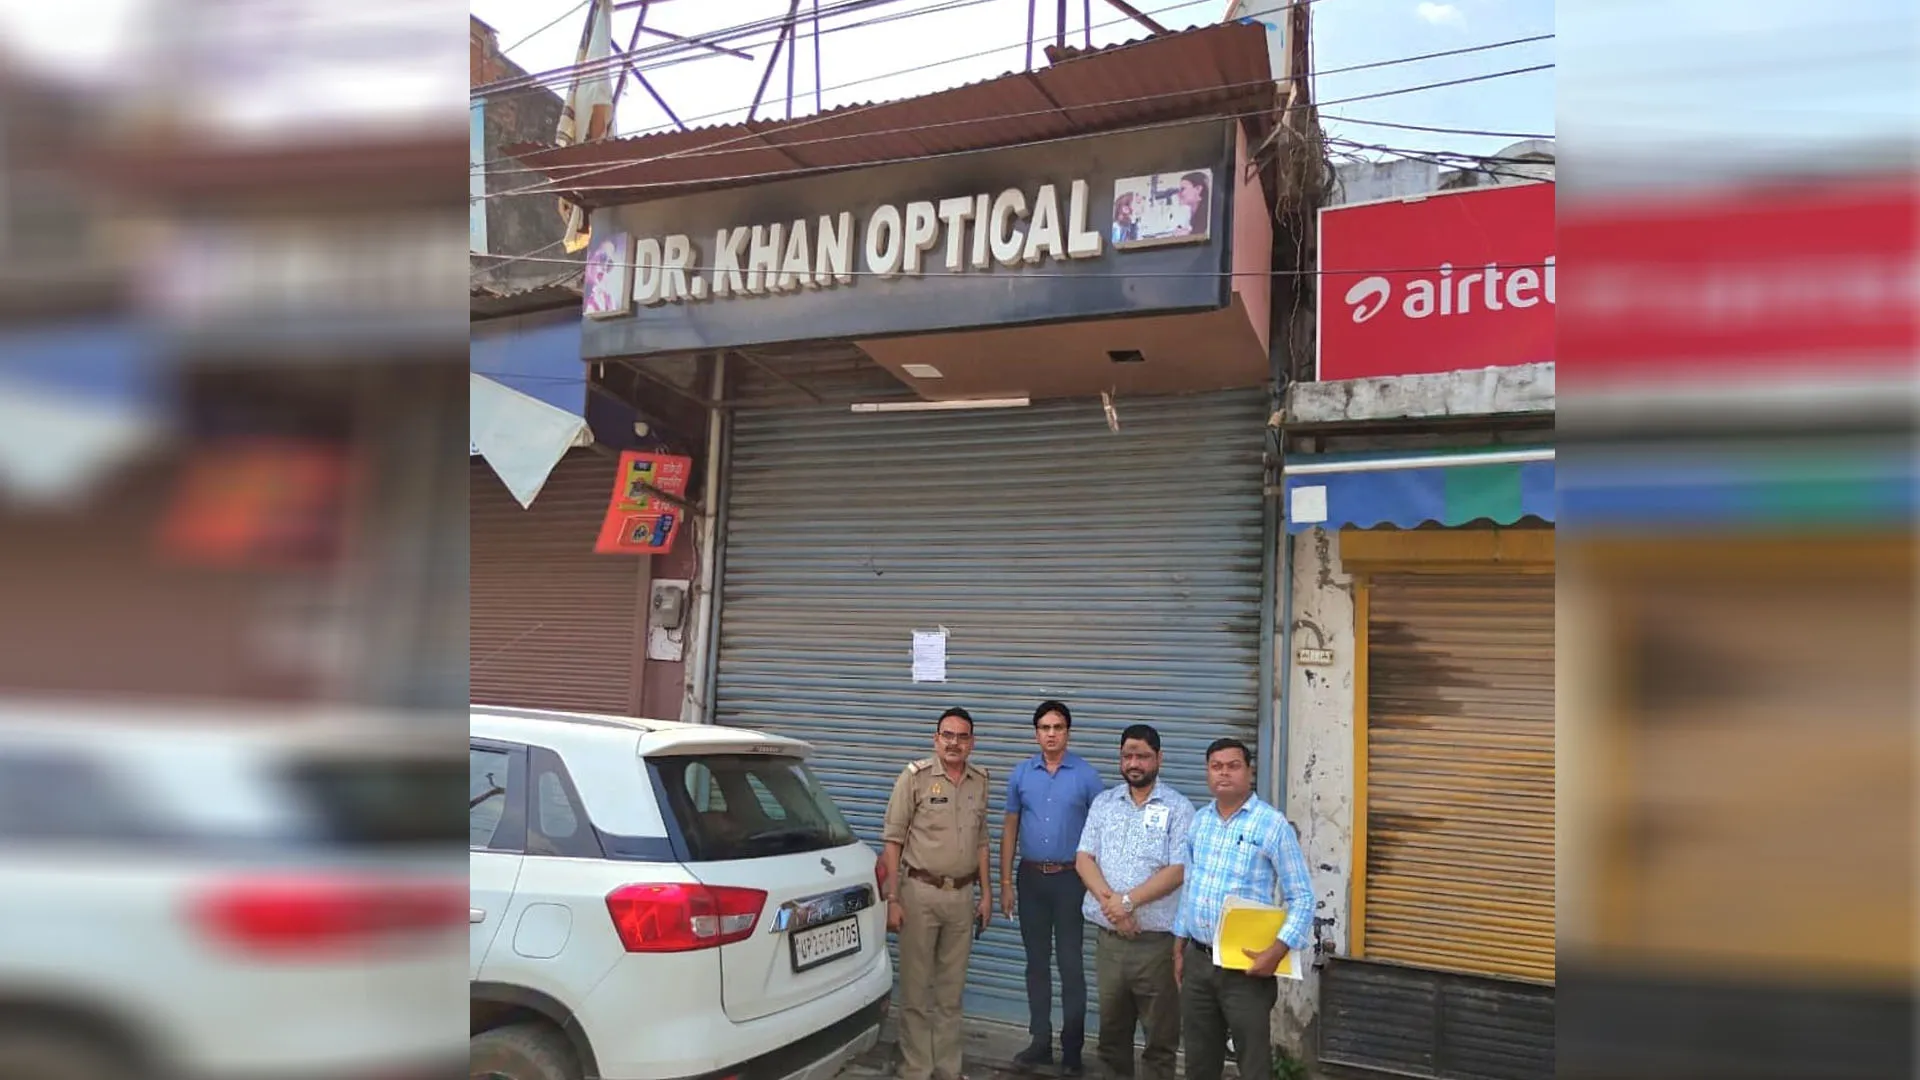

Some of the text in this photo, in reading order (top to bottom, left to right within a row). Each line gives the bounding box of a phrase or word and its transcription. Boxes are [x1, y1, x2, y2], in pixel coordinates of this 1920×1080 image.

[632, 179, 1103, 305] DR. KHAN OPTICAL
[1402, 256, 1555, 319] airtel
